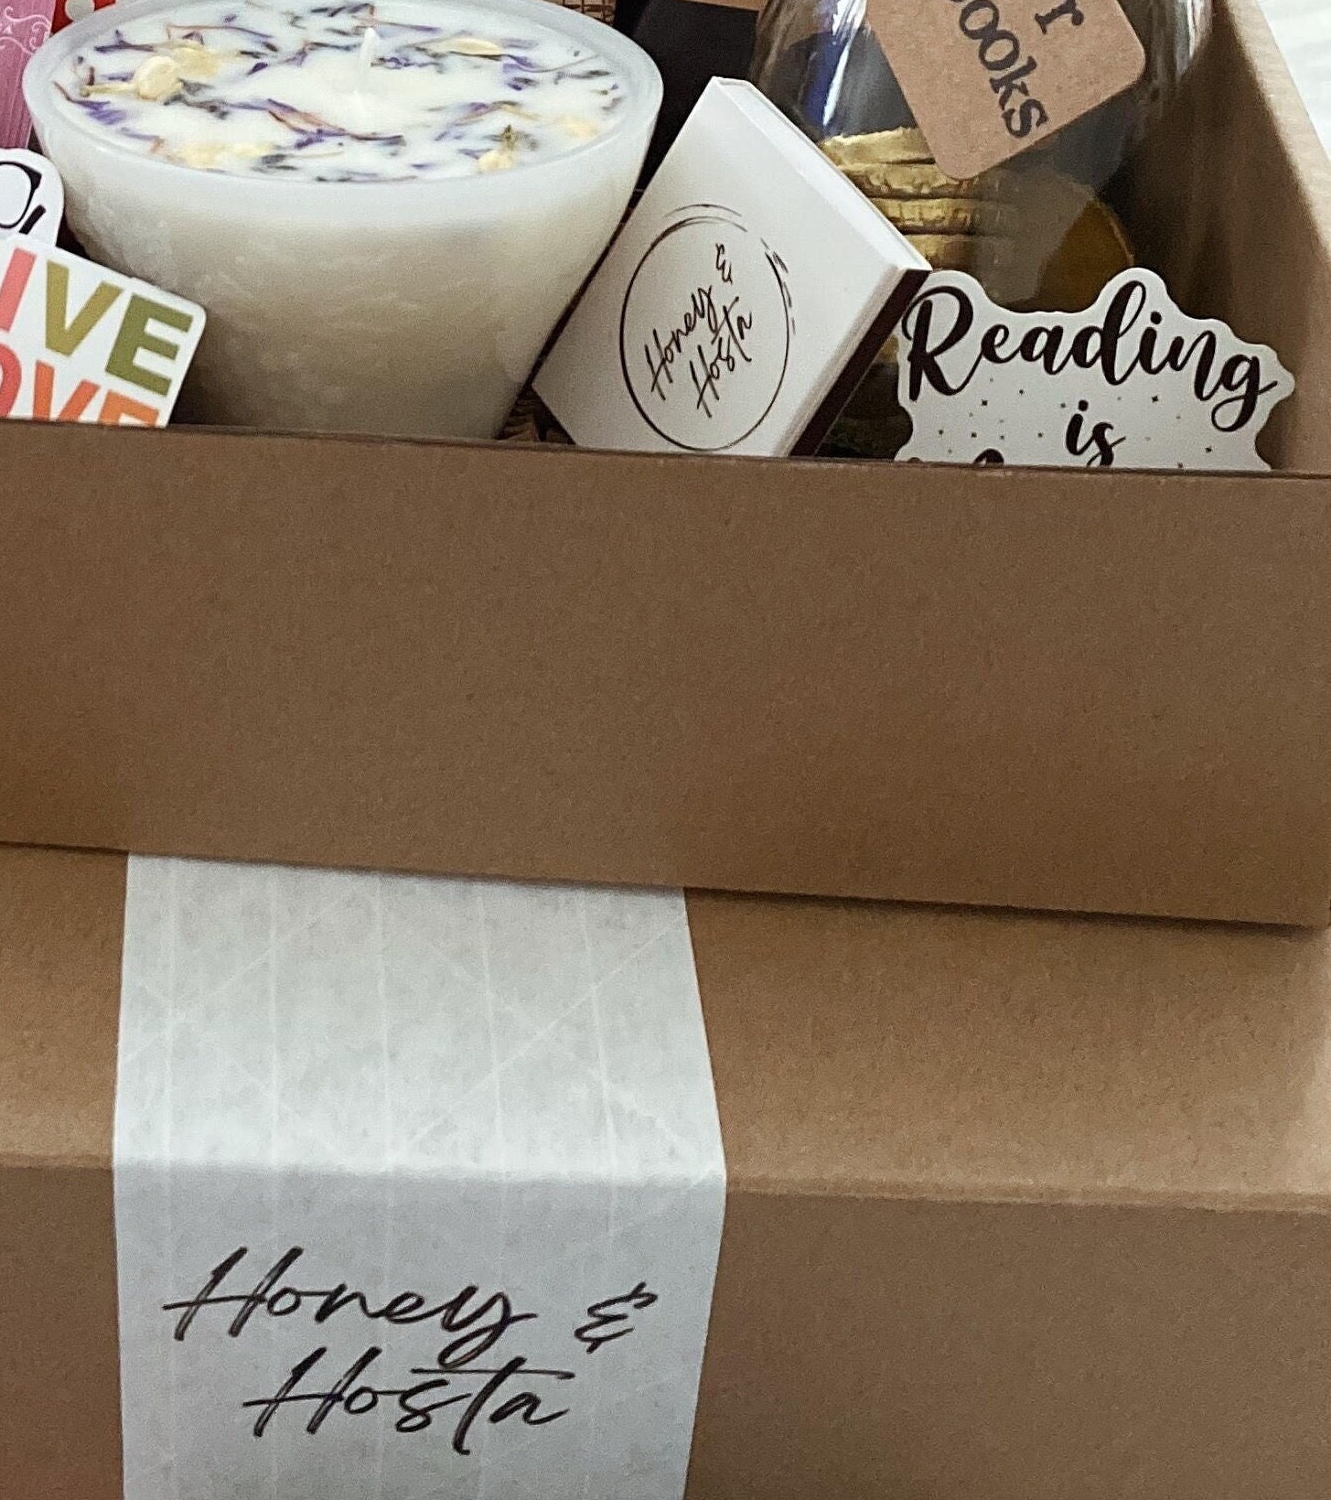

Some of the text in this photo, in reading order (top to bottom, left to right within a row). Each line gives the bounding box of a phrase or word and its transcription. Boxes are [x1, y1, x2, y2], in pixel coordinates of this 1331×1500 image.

[904, 281, 1278, 431] Reading
[1066, 399, 1127, 466] is
[164, 1246, 537, 1367] Honey
[242, 1347, 575, 1455] Hosta
